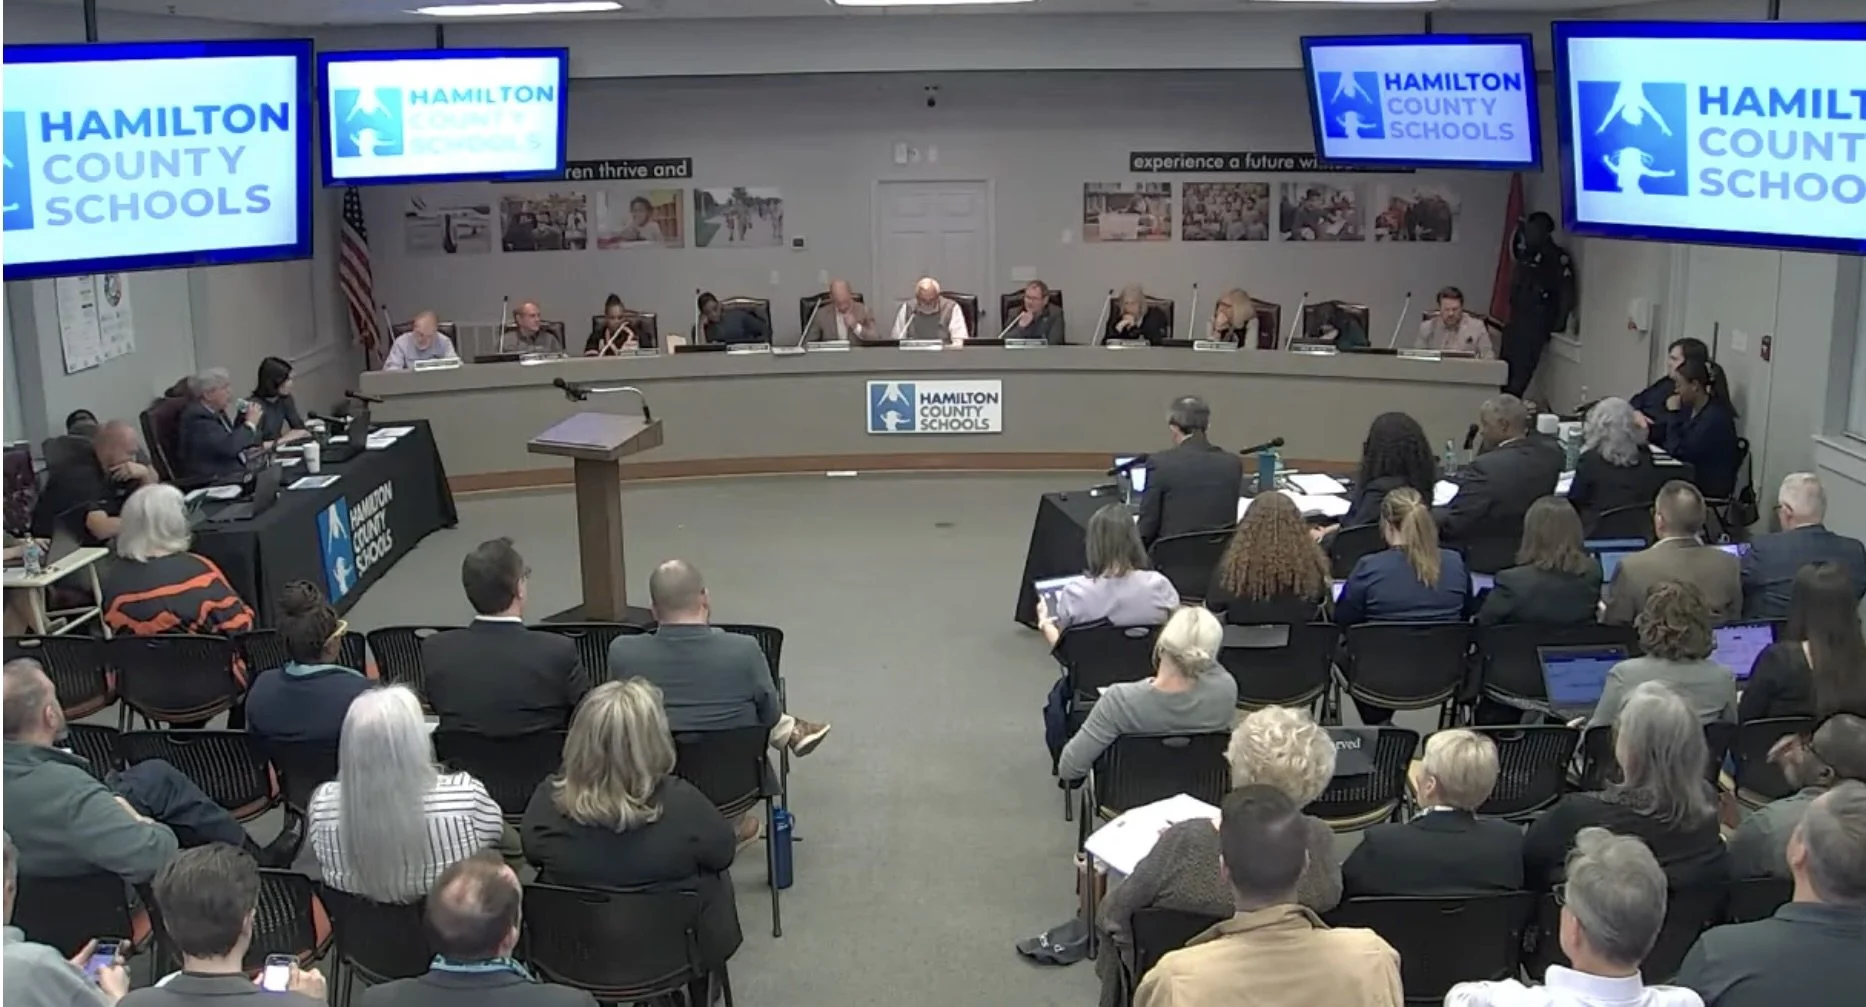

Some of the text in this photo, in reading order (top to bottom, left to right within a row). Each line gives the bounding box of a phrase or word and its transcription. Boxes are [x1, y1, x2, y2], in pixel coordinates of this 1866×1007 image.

[1384, 72, 1522, 92] HAMILTON
[410, 85, 554, 105] HAMILTON
[1387, 97, 1497, 116] COUNTY
[40, 102, 290, 143] HAMILTON
[1390, 121, 1515, 141] SCHOOLS
[42, 145, 247, 185] COUNTY
[599, 161, 648, 179] thrive
[653, 160, 688, 177] and
[1134, 154, 1224, 171] experience
[1229, 158, 1240, 169] a
[1245, 152, 1294, 169] future
[45, 184, 272, 227] SCHOOLS
[920, 392, 999, 405] HAMILTON
[920, 405, 984, 418] COUNTY
[920, 418, 990, 430] SCHOOLS
[349, 479, 393, 531] HAMILTON
[352, 507, 387, 554] COUNTY
[355, 528, 393, 578] SCHOOLS
